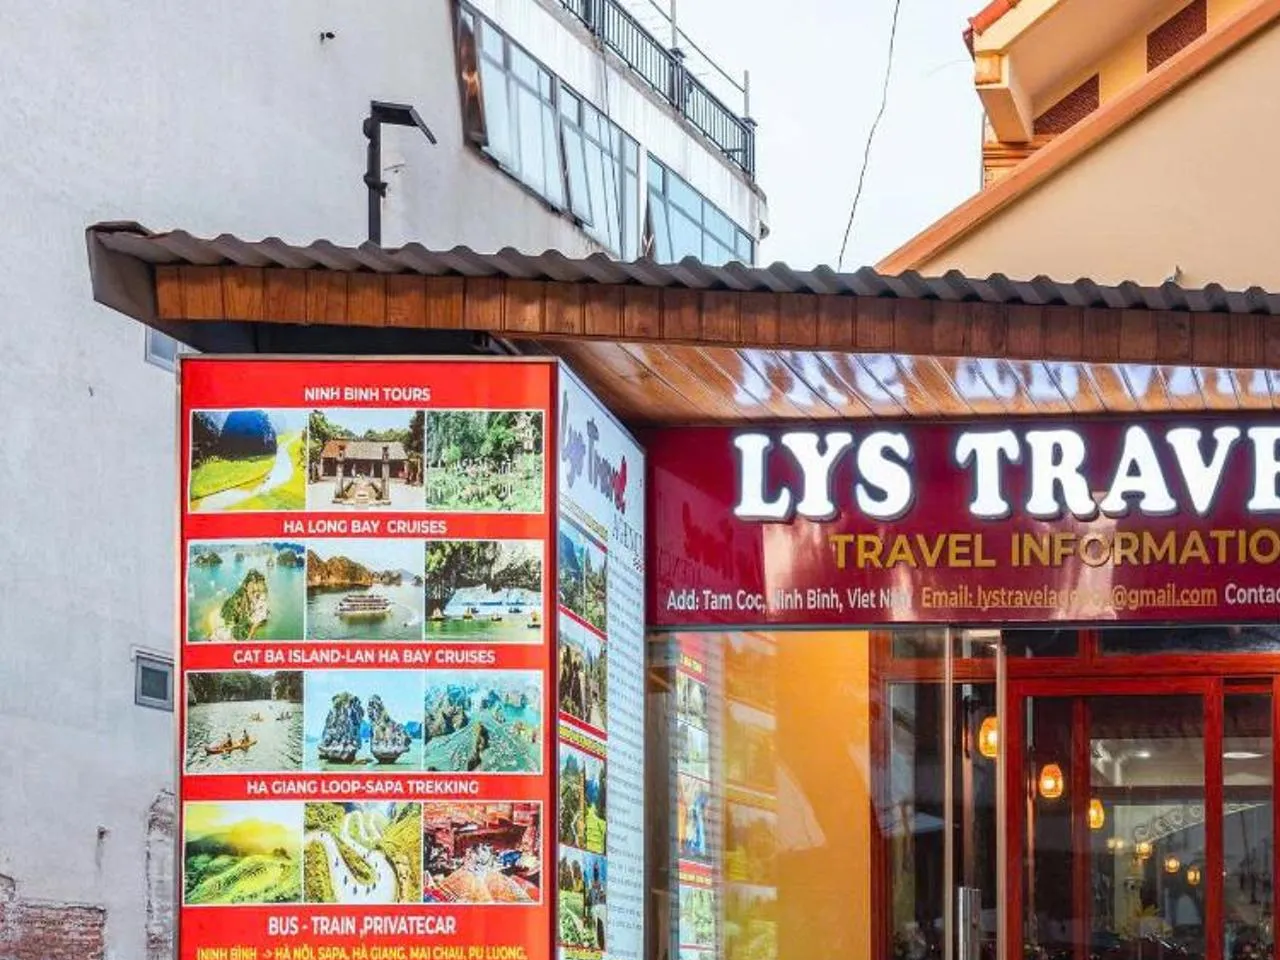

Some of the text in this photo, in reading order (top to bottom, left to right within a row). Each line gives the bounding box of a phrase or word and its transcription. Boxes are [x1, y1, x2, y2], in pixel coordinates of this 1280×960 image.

[304, 387, 431, 401] NINH BINH TOURS
[733, 427, 914, 522] LYS
[283, 520, 447, 535] HA LONG BAY CRUISES
[830, 533, 996, 569] TRAVEL
[667, 590, 699, 609] Add:
[703, 590, 732, 609] Tam
[736, 591, 767, 613] Coc,
[806, 589, 843, 613] Binh,
[847, 588, 876, 608] Viet
[921, 586, 973, 608] Email:
[233, 649, 496, 664] CAT BA ISLAND-LAN HA BAY CRUISES
[247, 780, 479, 794] HA GIANG LOOP-SAPA TREKKING
[268, 916, 299, 936] BUS
[311, 916, 356, 935] TRAIN
[410, 947, 431, 960] MAI
